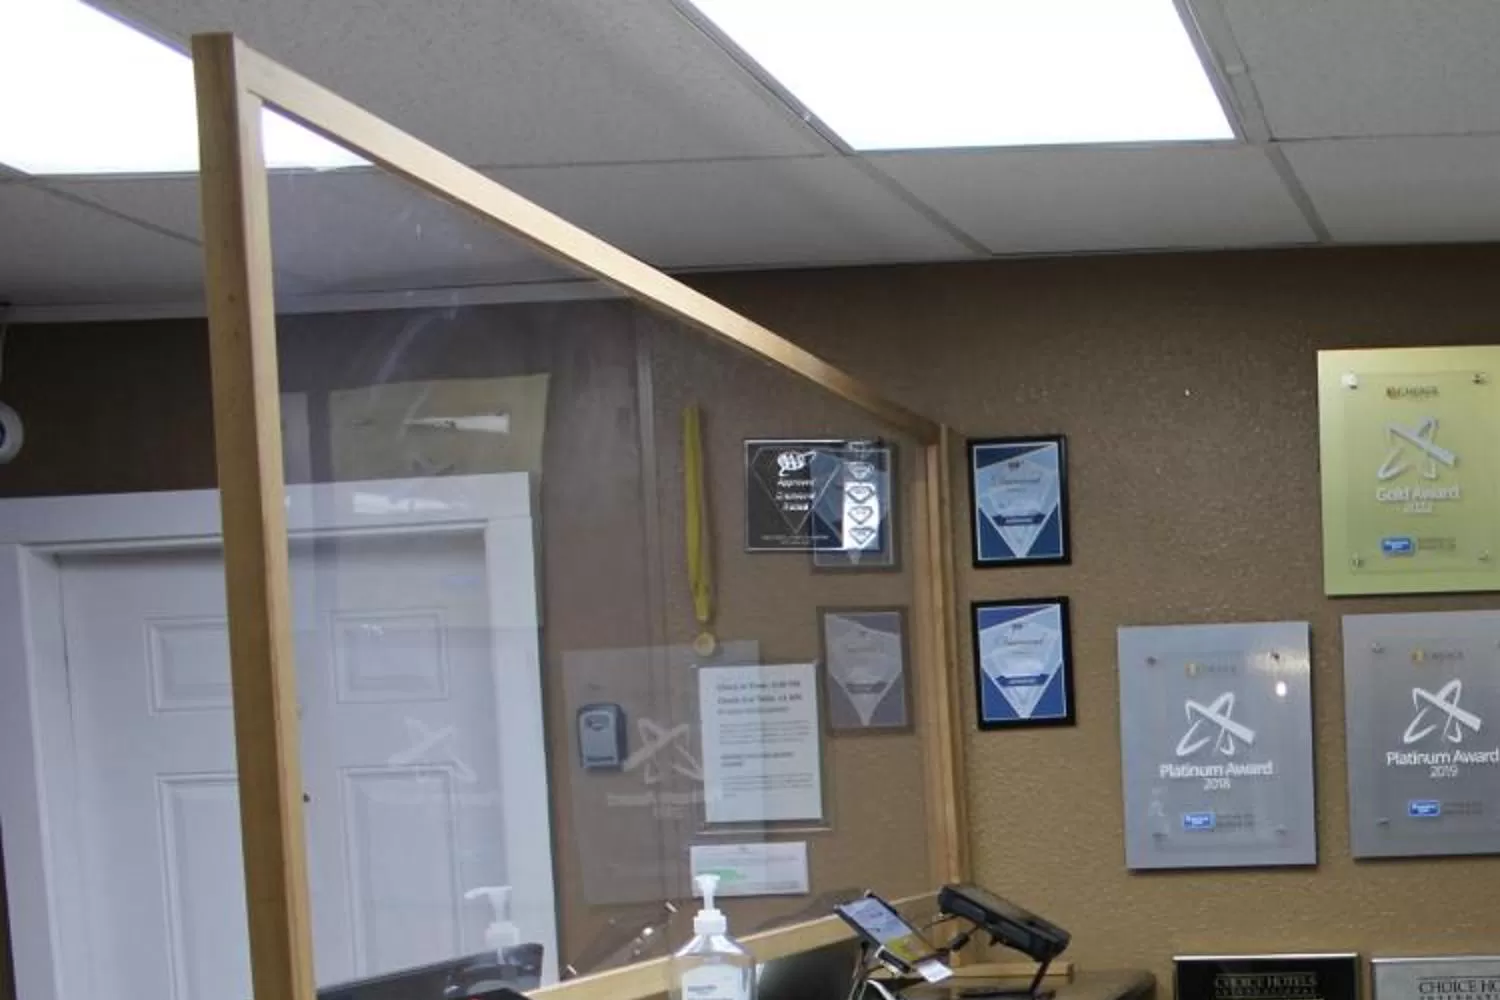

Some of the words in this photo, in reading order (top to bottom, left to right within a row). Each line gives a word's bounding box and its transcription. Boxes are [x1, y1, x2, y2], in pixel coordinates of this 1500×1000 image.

[1375, 486, 1410, 502] Gold
[1412, 484, 1461, 500] Award
[1385, 750, 1451, 767] Platinum
[1453, 748, 1500, 764] Award
[1159, 763, 1224, 779] Platinum
[1225, 760, 1274, 776] Award
[1418, 979, 1477, 994] CHOICE
